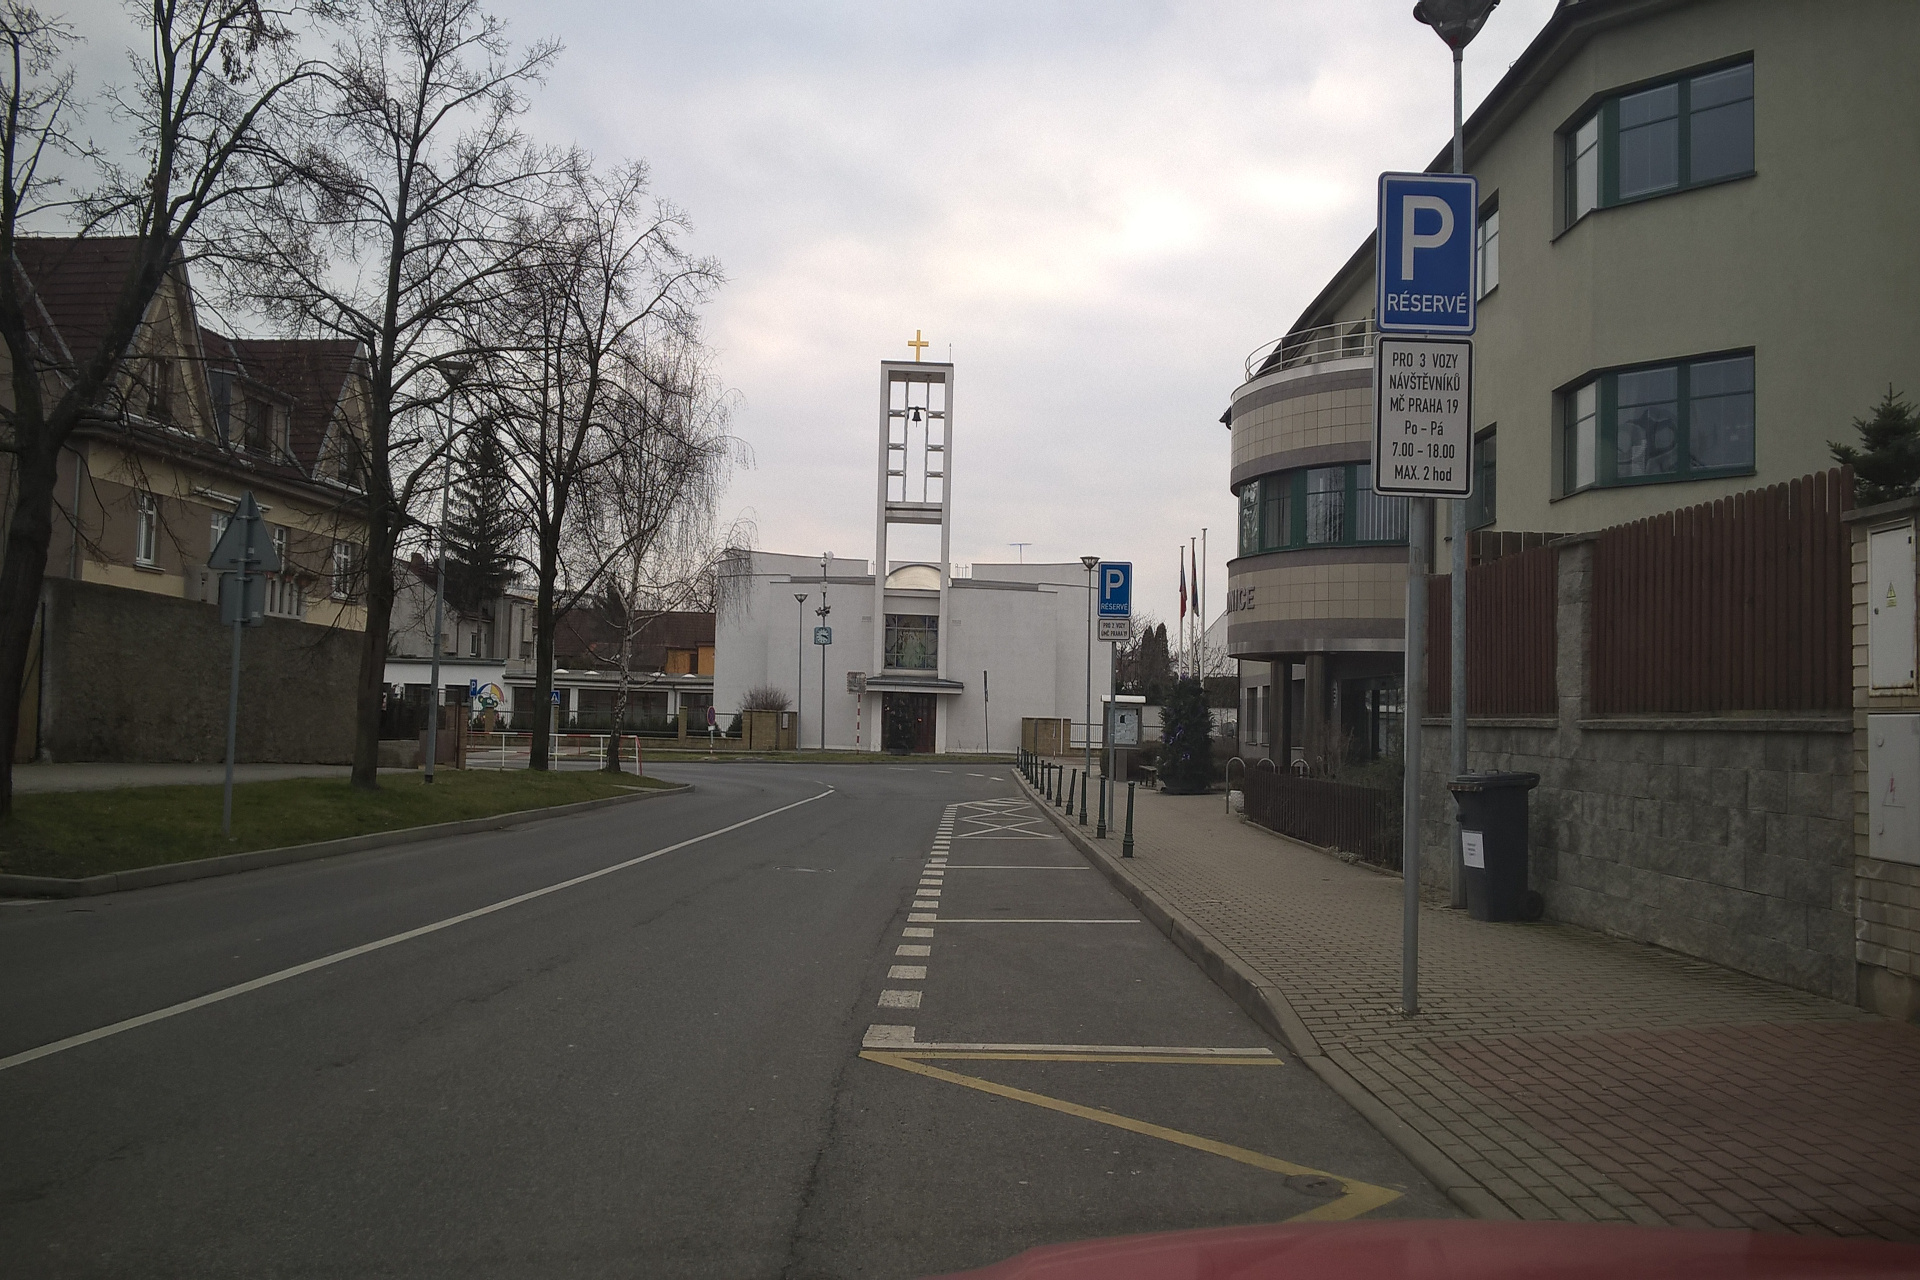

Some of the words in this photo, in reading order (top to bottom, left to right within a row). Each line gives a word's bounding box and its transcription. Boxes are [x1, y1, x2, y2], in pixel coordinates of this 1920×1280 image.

[1401, 194, 1455, 281] P
[1387, 290, 1467, 314] RÉSERVÉ
[1392, 352, 1413, 367] PRO
[1420, 353, 1426, 368] 3
[1432, 353, 1458, 369] VOZY
[1389, 371, 1460, 391] NÁVŠTĚVNÍKŮ
[1390, 394, 1405, 412] MČ
[1408, 397, 1443, 413] PRAHA
[1446, 399, 1459, 414] 19
[1404, 420, 1418, 435] Po
[1430, 421, 1443, 436] Pá
[1392, 441, 1414, 457] 7.00
[1427, 443, 1455, 459] 18.00
[1394, 464, 1420, 480] MAX.
[1423, 466, 1430, 481] 2
[1433, 466, 1452, 482] hod
[1105, 569, 1124, 600] P
[1100, 602, 1129, 611] RÉSERVÉ
